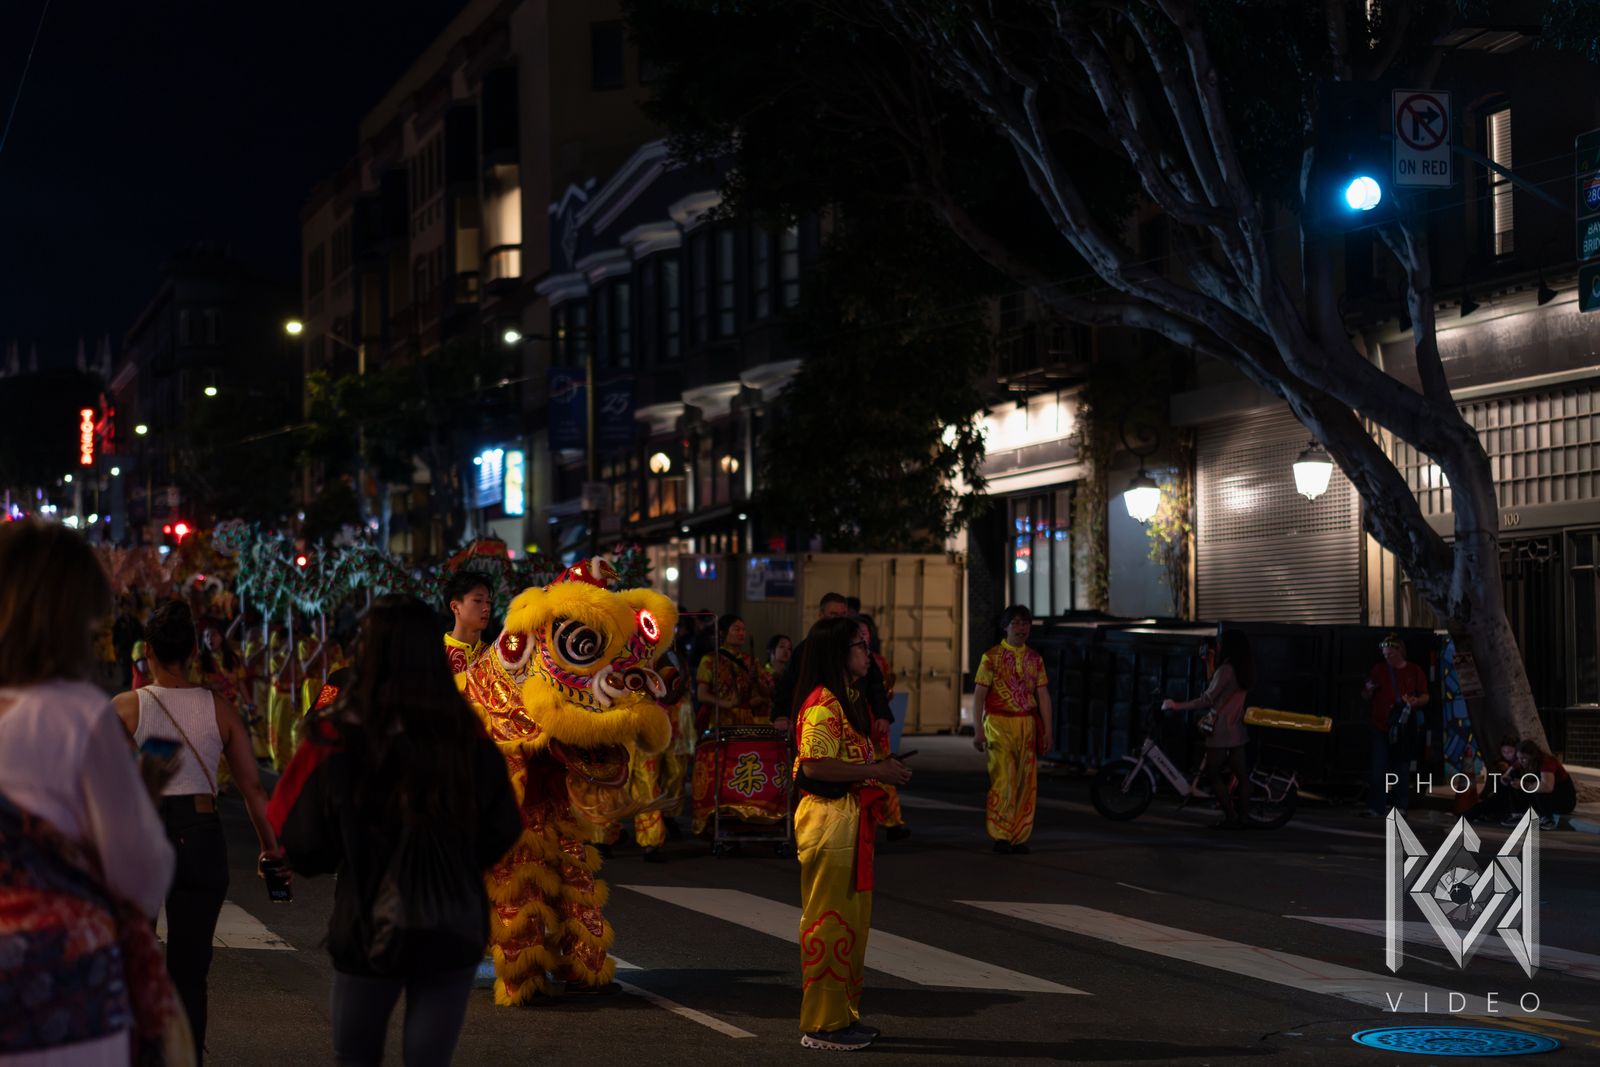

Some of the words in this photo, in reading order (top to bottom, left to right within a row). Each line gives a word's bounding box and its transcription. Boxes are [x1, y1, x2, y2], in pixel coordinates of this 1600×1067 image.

[1399, 159, 1416, 175] ON
[1422, 160, 1448, 175] RED
[1504, 512, 1520, 526] 100
